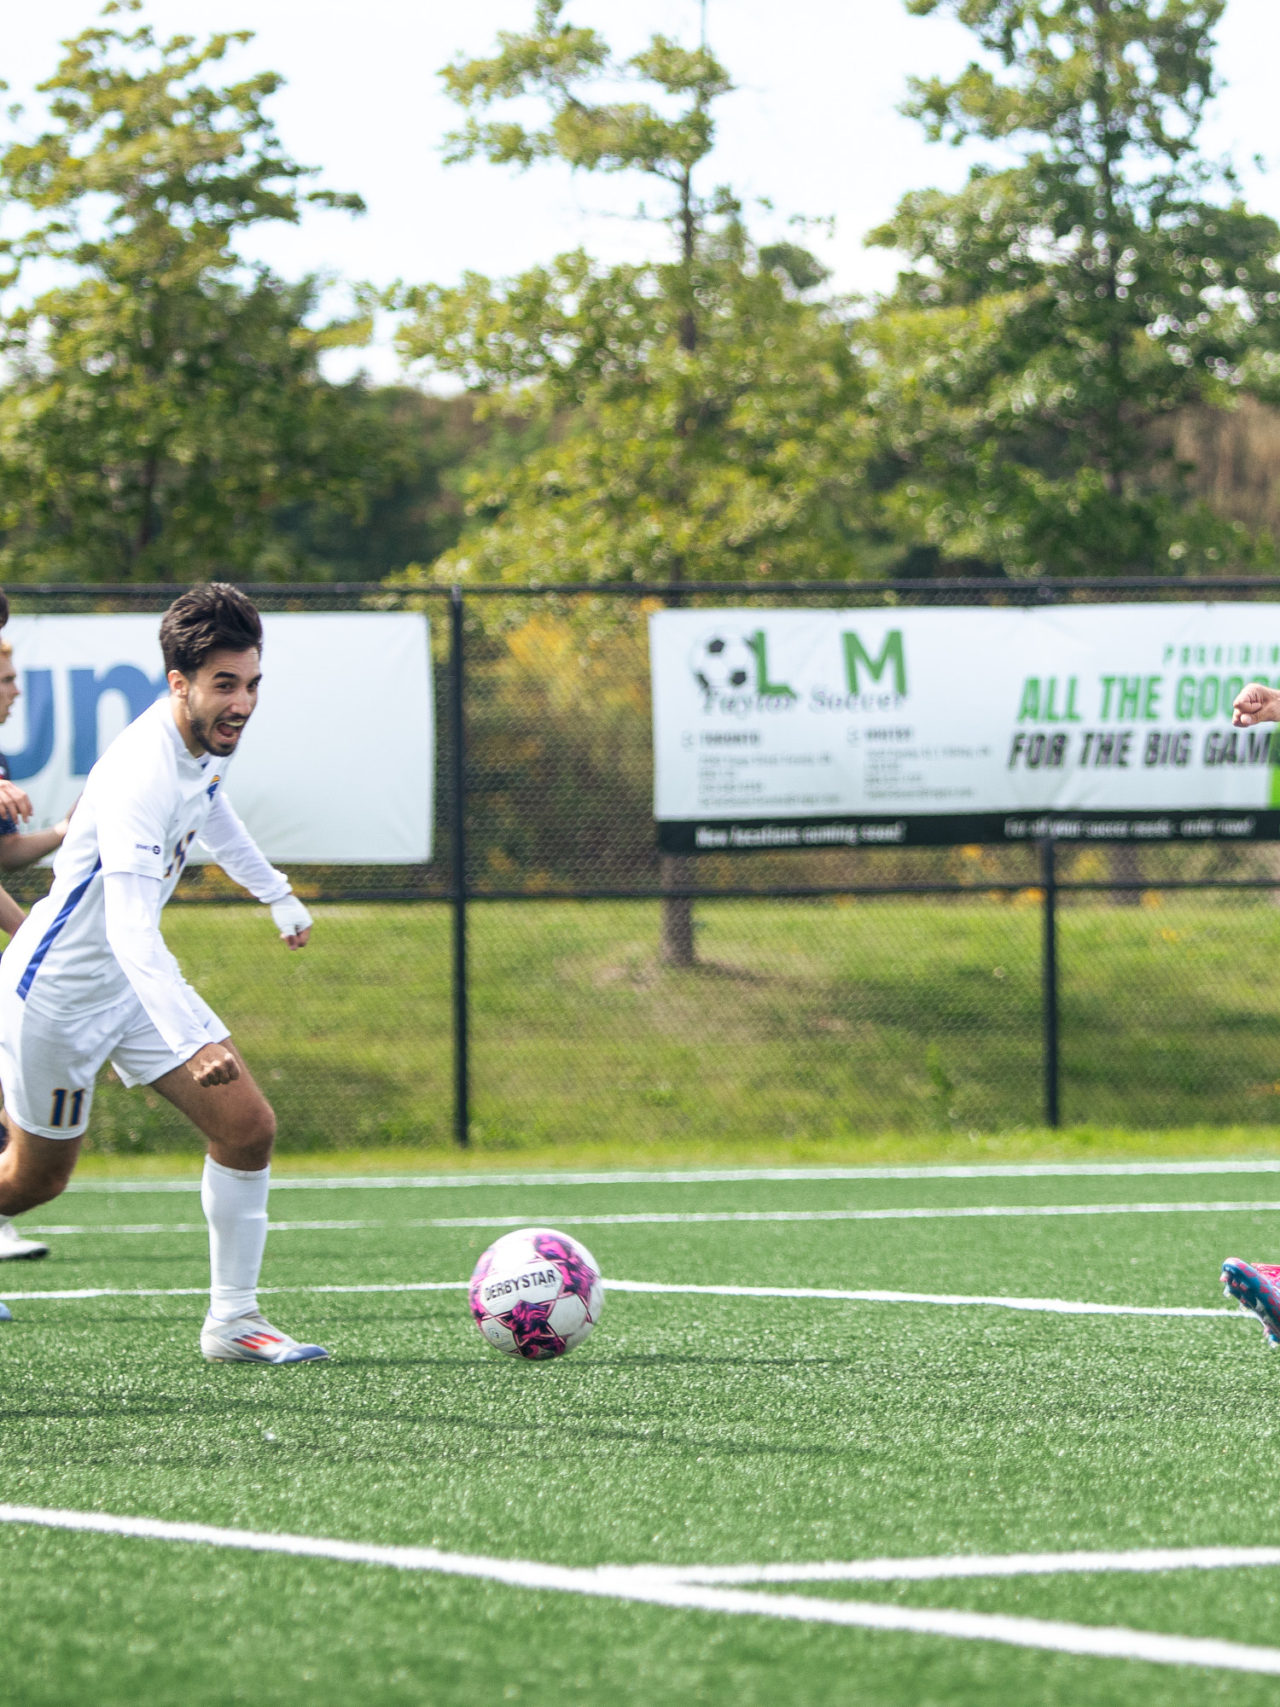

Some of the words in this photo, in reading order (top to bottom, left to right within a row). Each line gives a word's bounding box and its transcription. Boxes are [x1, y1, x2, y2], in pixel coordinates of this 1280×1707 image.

[1017, 675, 1081, 722] ALL
[1100, 675, 1162, 720] THE
[1008, 731, 1068, 768] FOR
[1080, 730, 1133, 767] THE
[1144, 731, 1193, 767] BIG
[48, 1087, 86, 1128] 11
[484, 1269, 557, 1302] DERBYSTAR
